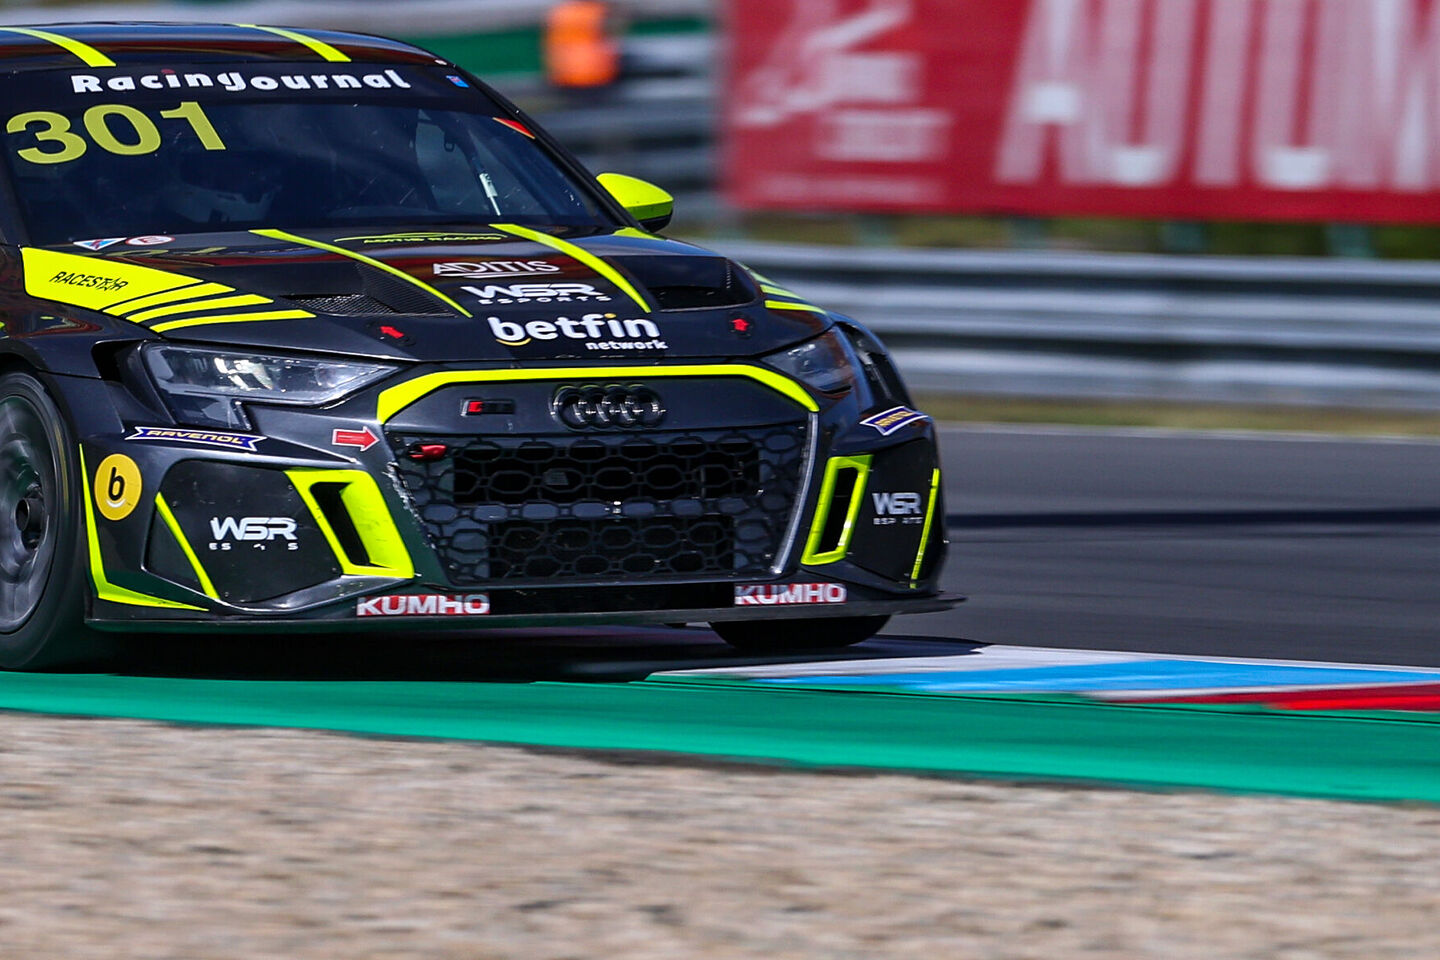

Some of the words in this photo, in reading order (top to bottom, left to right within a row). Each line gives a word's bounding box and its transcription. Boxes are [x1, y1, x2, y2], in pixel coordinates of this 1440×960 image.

[6, 101, 226, 165] 301
[433, 261, 560, 274] ADITIS
[460, 283, 604, 299] WSR
[487, 313, 661, 341] betfin
[585, 340, 669, 350] network
[210, 517, 298, 541] WSR
[357, 594, 490, 615] KUMHO
[734, 583, 847, 605] KUMHO
